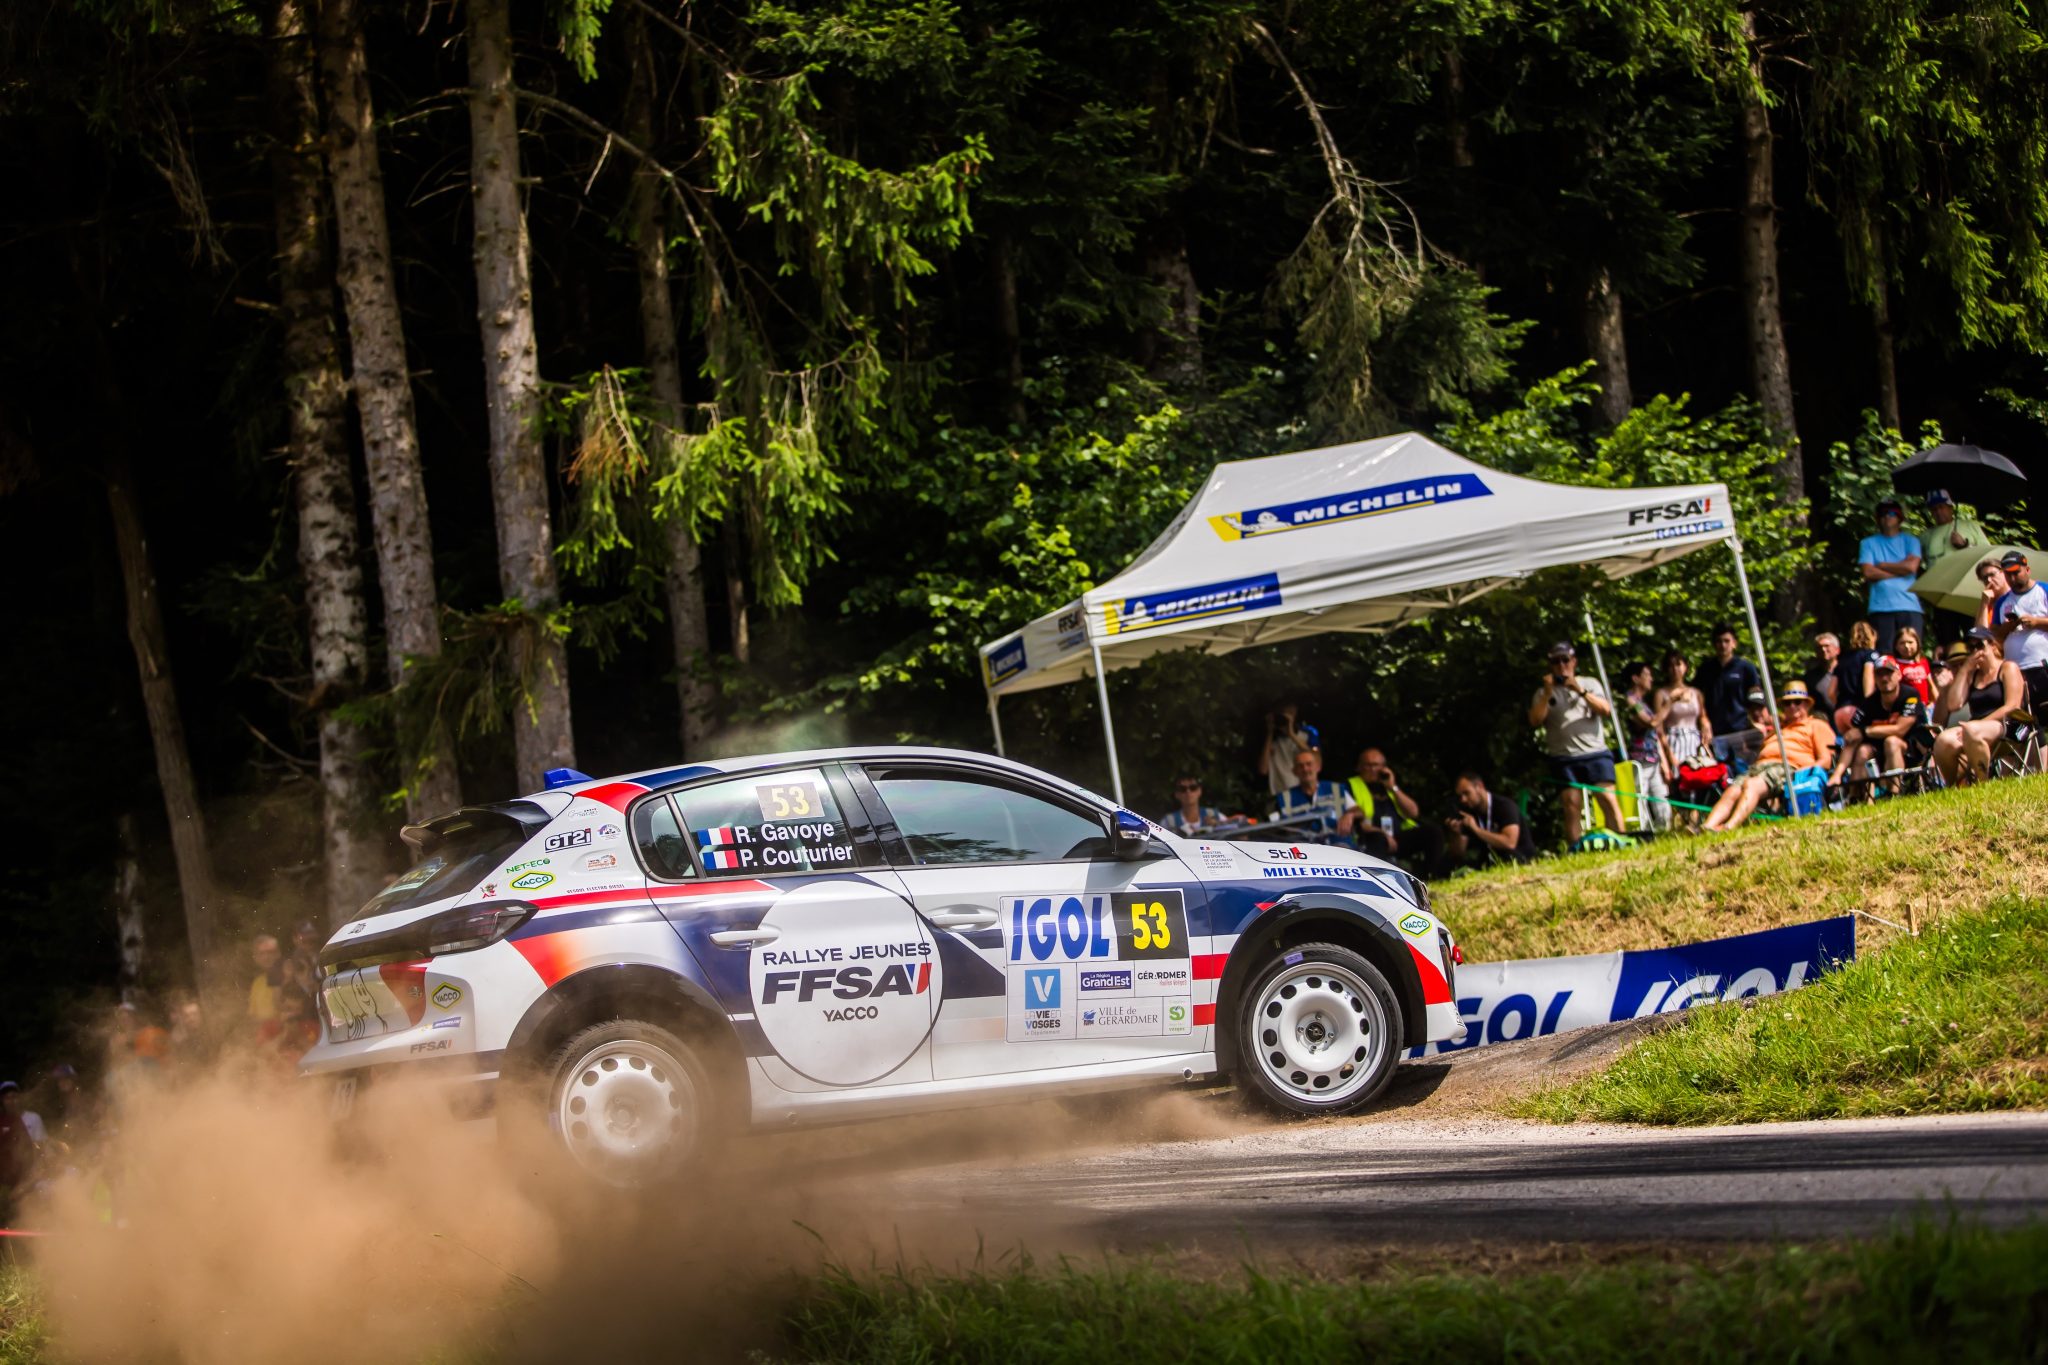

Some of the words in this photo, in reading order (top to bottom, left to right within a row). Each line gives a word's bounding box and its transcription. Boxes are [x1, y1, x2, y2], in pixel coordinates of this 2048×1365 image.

[1294, 482, 1462, 522] MICHELIN
[1628, 499, 1703, 526] FFSA
[1154, 585, 1266, 617] MICHELIN
[771, 785, 810, 817] 53
[545, 827, 592, 852] GT2i
[734, 825, 757, 844] R.
[761, 822, 835, 843] Gavoye
[740, 849, 758, 868] P.
[762, 843, 853, 866] Couturier
[1268, 846, 1308, 861] Stilo
[517, 874, 550, 887] YACCO
[1263, 867, 1307, 878] MILLE
[1312, 867, 1362, 878] PIECES
[1011, 897, 1110, 961] IGOL
[1131, 902, 1171, 950] 53
[1403, 920, 1428, 929] YACCO
[762, 947, 843, 966] RALLYE
[848, 942, 932, 960] JEUNES
[762, 963, 914, 1005] FFSA
[436, 991, 458, 1003] YACCO
[823, 1005, 879, 1022] YACCO
[1036, 1010, 1051, 1019] VIE
[1099, 1007, 1124, 1016] VILLE
[1126, 1006, 1137, 1015] de
[1025, 1019, 1061, 1029] VOSGES
[410, 1040, 448, 1054] FFSA
